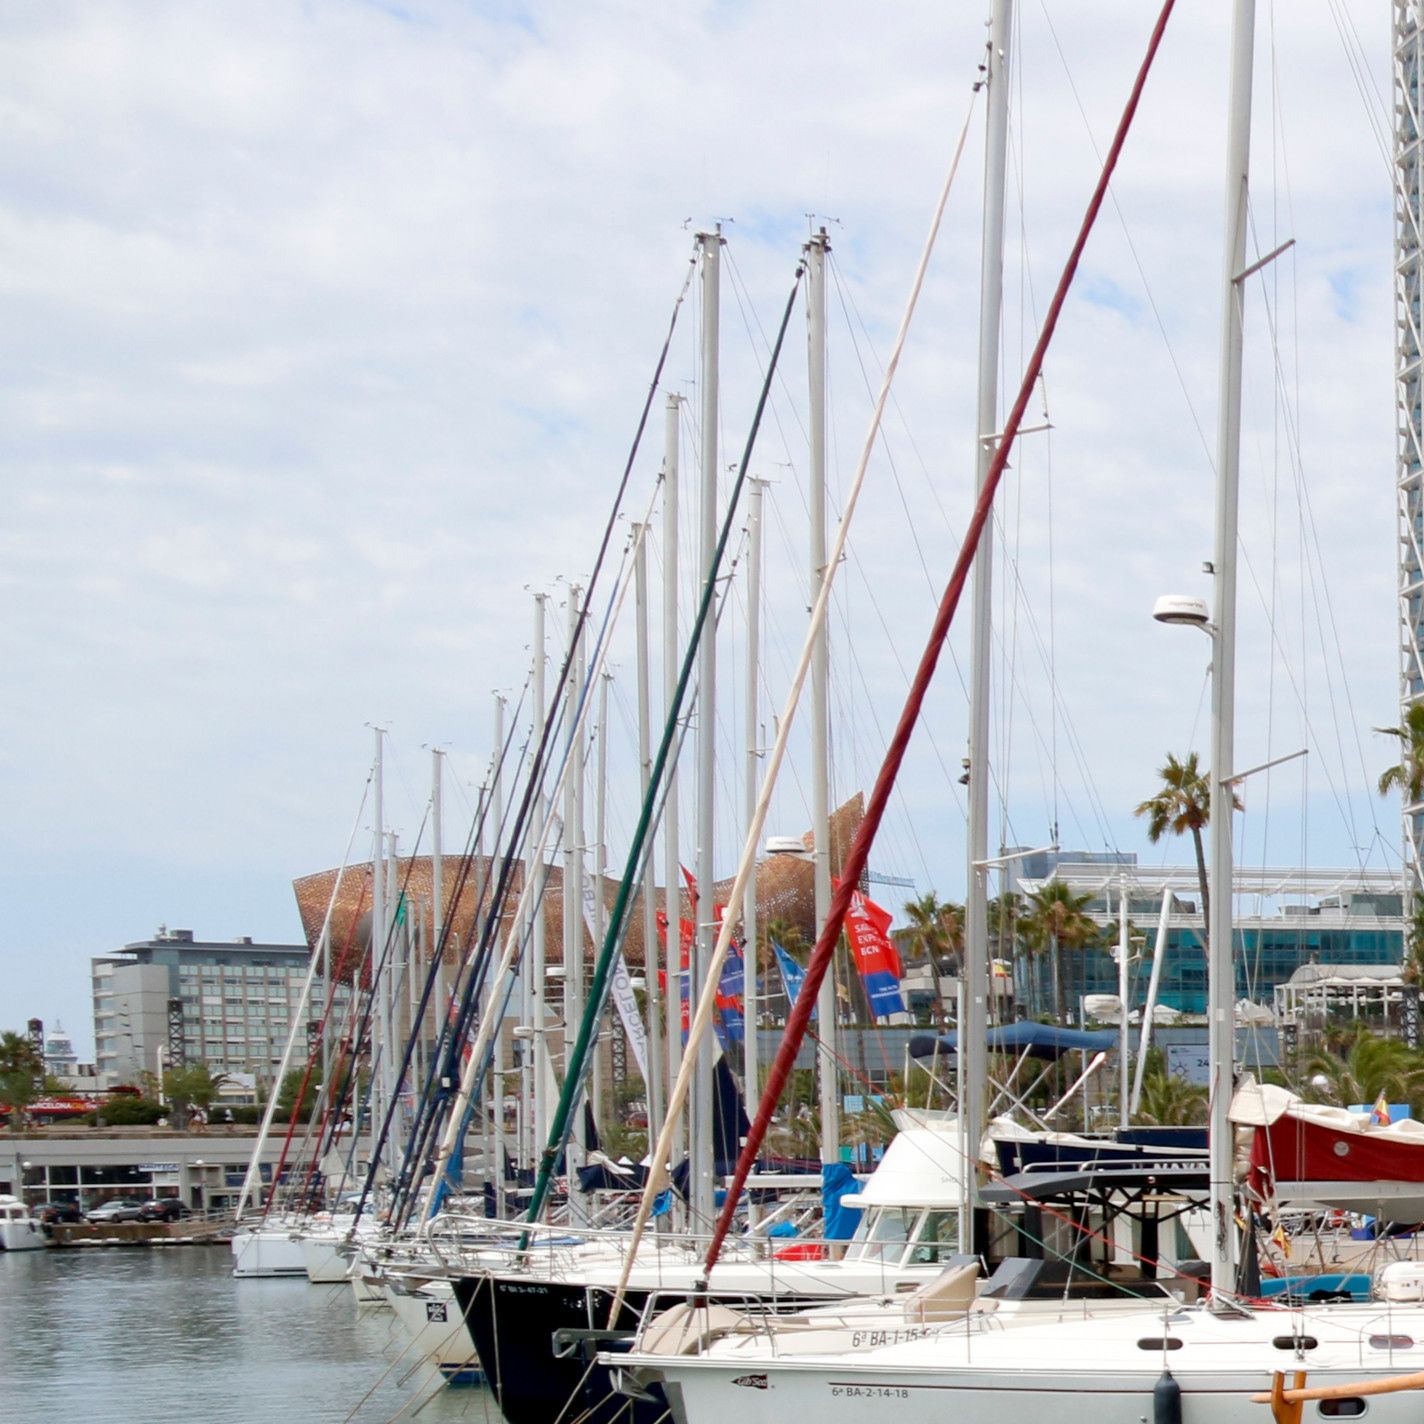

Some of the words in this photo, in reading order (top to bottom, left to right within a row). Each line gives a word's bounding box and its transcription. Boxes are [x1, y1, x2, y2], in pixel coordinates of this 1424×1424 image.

[860, 945, 880, 956] BCN
[832, 1387, 844, 1397] 6ª
[846, 1387, 909, 1399] BA-2-14-18
